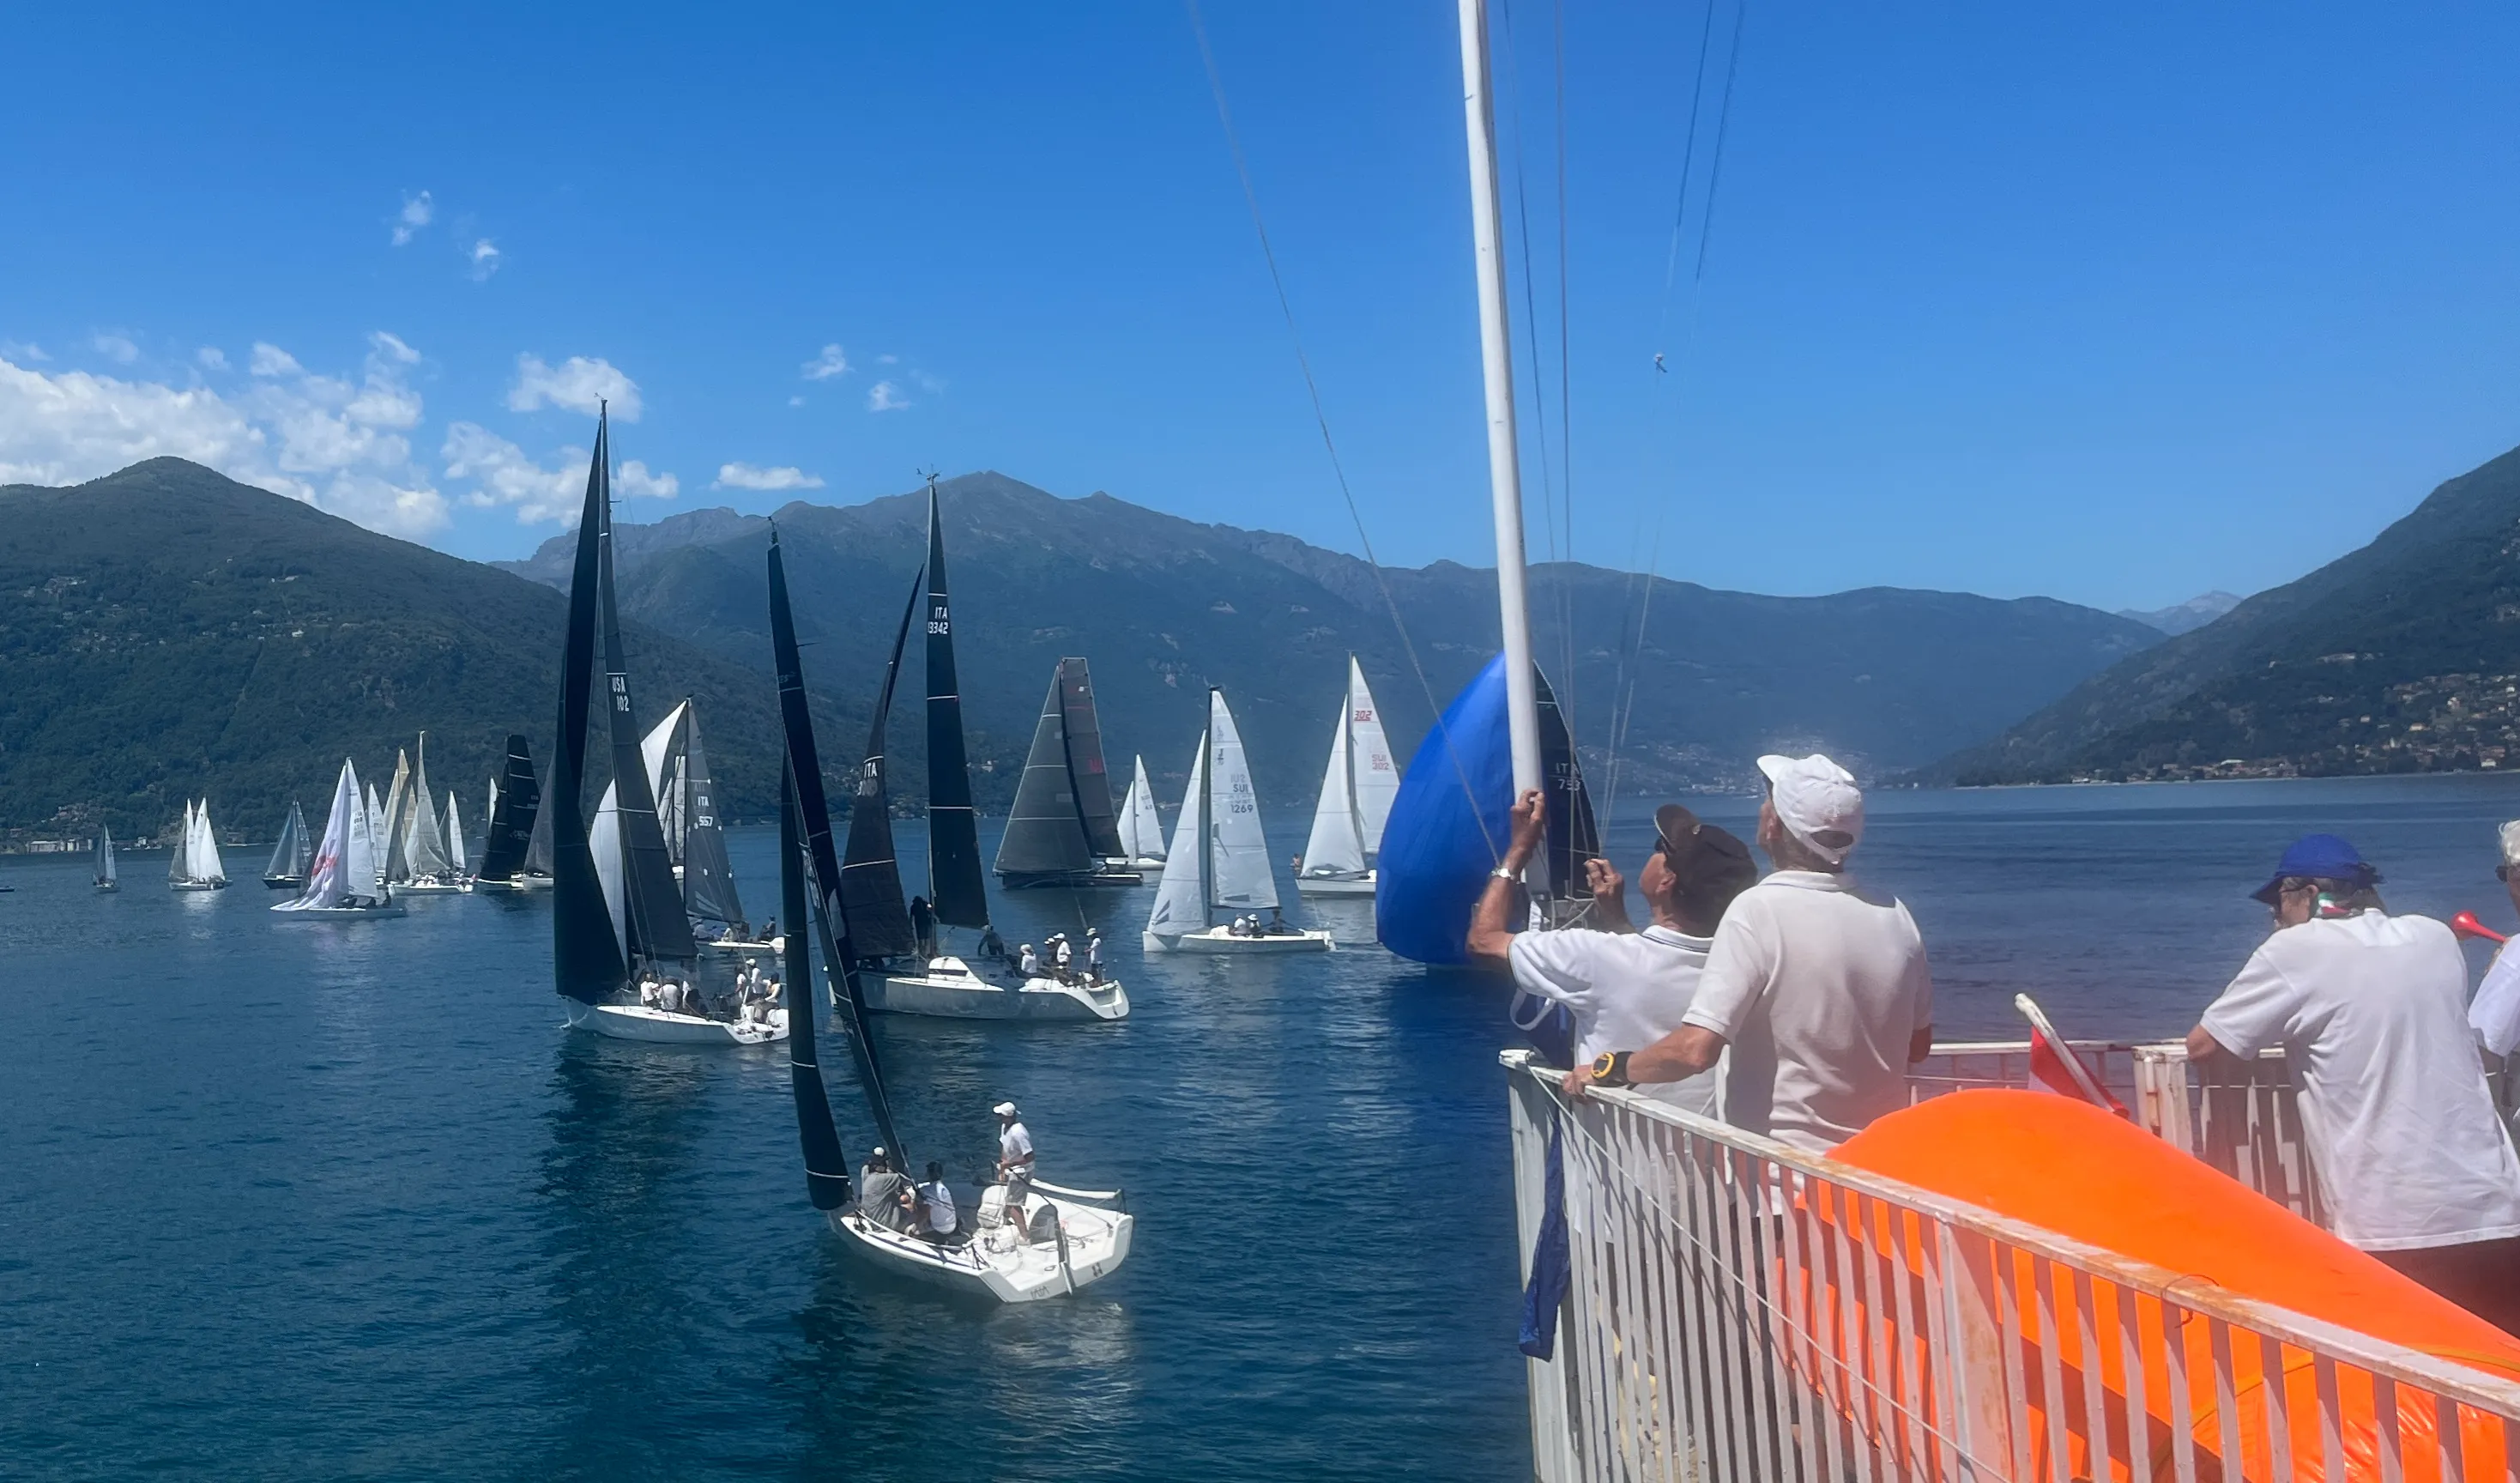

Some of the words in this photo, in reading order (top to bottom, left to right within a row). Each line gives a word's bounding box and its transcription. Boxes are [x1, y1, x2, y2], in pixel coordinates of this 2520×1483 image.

[934, 606, 947, 619] ITA
[612, 676, 626, 693] USA
[616, 695, 629, 711] 102
[1354, 710, 1372, 722] 302
[864, 762, 878, 778] ITA
[1233, 784, 1248, 795] SUI
[698, 796, 710, 807] ITA
[1230, 803, 1254, 814] 1269
[698, 815, 714, 827] 557
